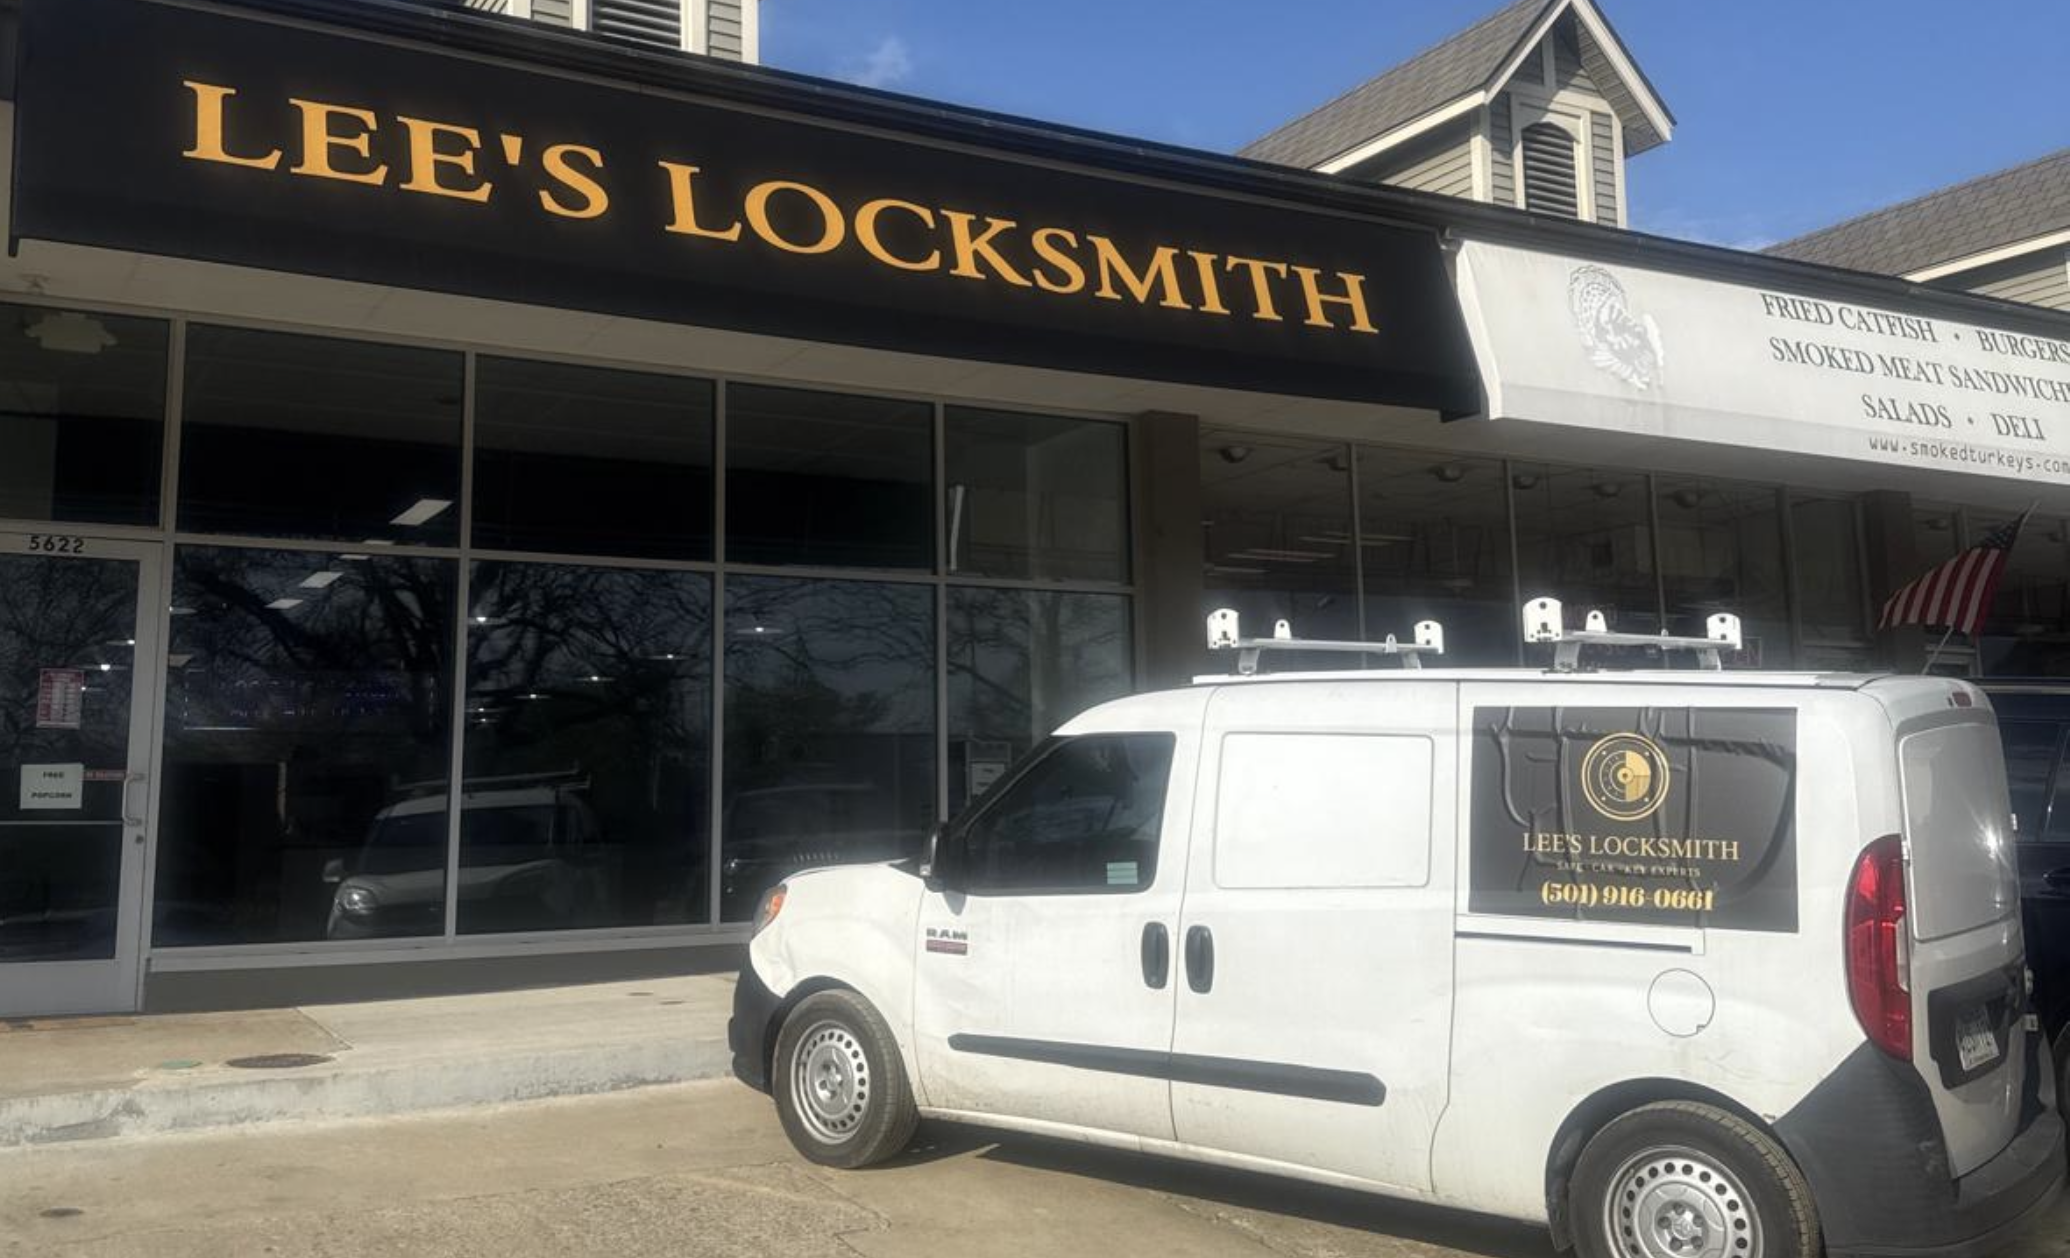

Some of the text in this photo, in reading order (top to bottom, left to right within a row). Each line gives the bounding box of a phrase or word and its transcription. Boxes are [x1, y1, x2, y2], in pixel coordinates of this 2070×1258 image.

[182, 79, 1379, 334] LEE'S LOCKSMITH
[1760, 292, 2070, 365] FRIED CATFISH BURGERS
[1768, 336, 2070, 403] SMOKED MEAT SANDWICH
[1860, 394, 2047, 441] SALADS DELI
[1868, 436, 2070, 474] www.smokedturkeys.com
[29, 535, 85, 554] 5622
[42, 771, 65, 779] FREE
[31, 791, 73, 799] POPCORN
[1522, 832, 1740, 861] LEE'S LOCKSMITH
[1650, 864, 1701, 878] EXPERTS
[1541, 880, 1598, 908] (501)
[926, 927, 968, 940] RAM
